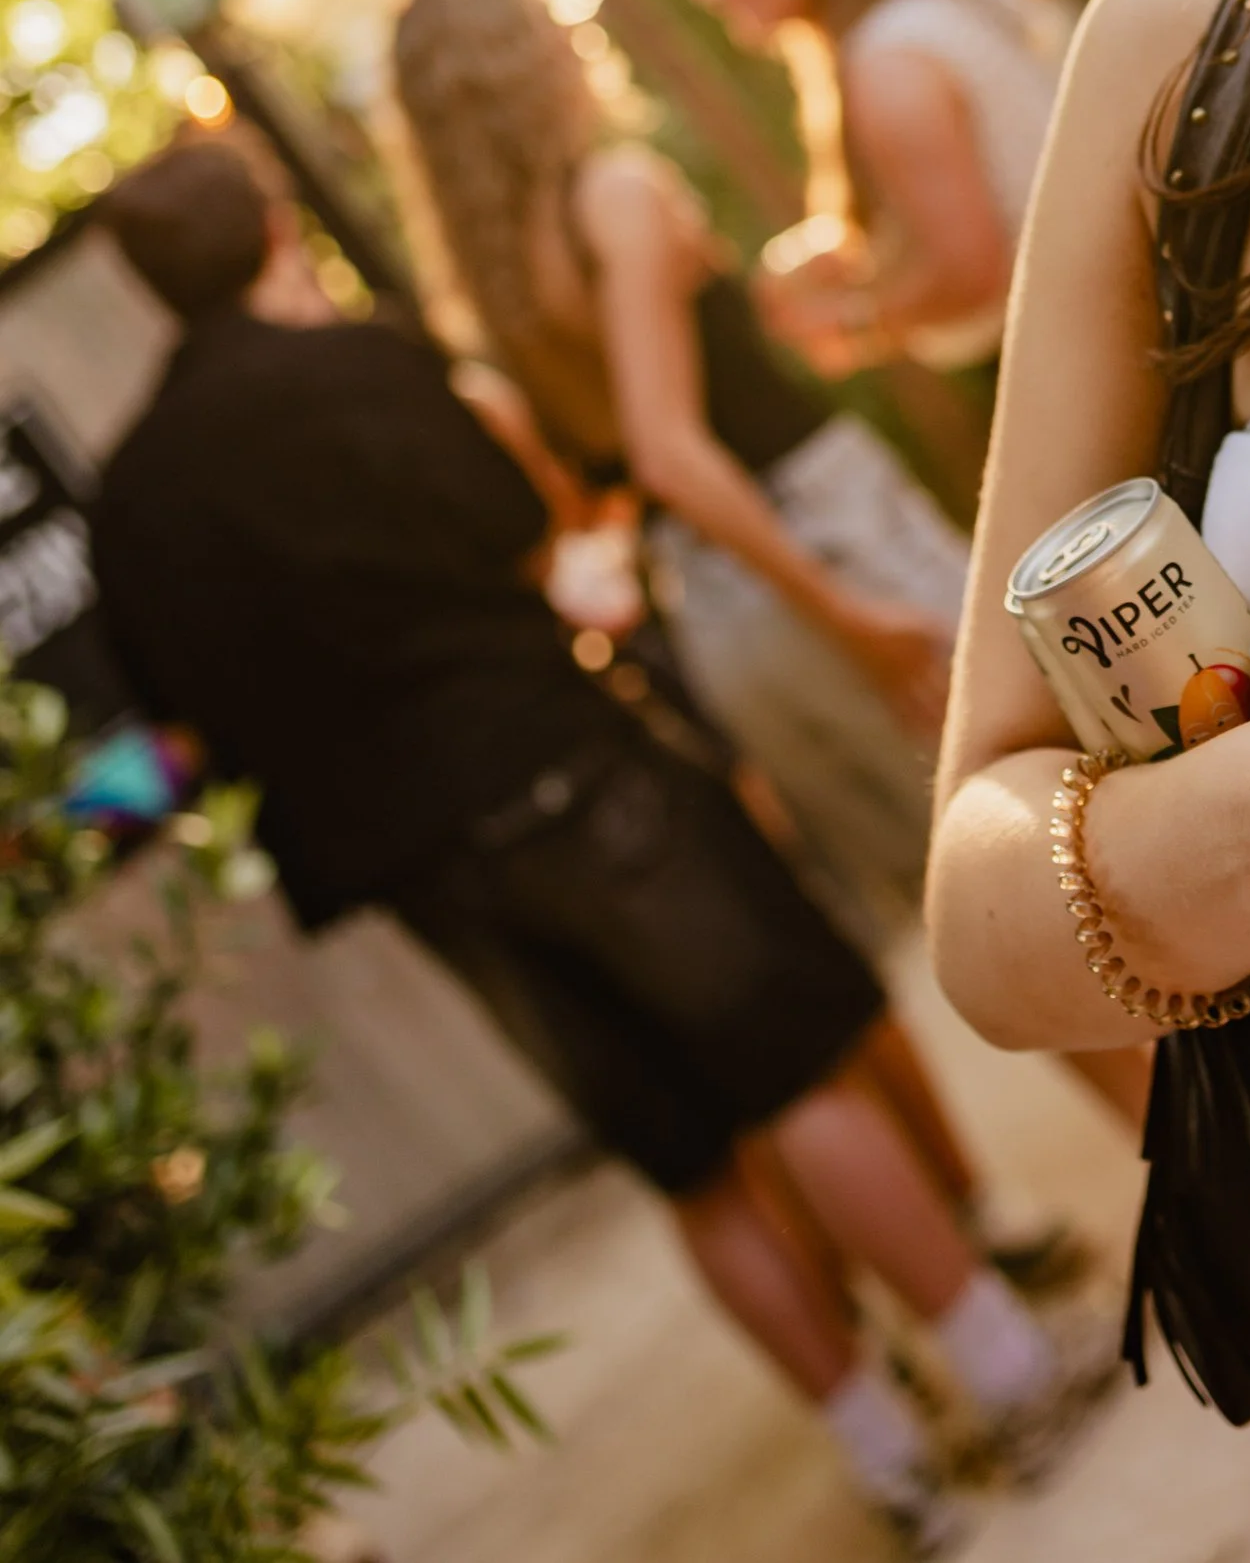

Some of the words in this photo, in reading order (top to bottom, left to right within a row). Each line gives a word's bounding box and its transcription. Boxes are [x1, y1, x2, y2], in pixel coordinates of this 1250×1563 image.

[1062, 562, 1193, 668] VIPER
[1116, 638, 1149, 659] HARD
[1151, 616, 1178, 641] ICED
[1177, 595, 1196, 615] TEA
